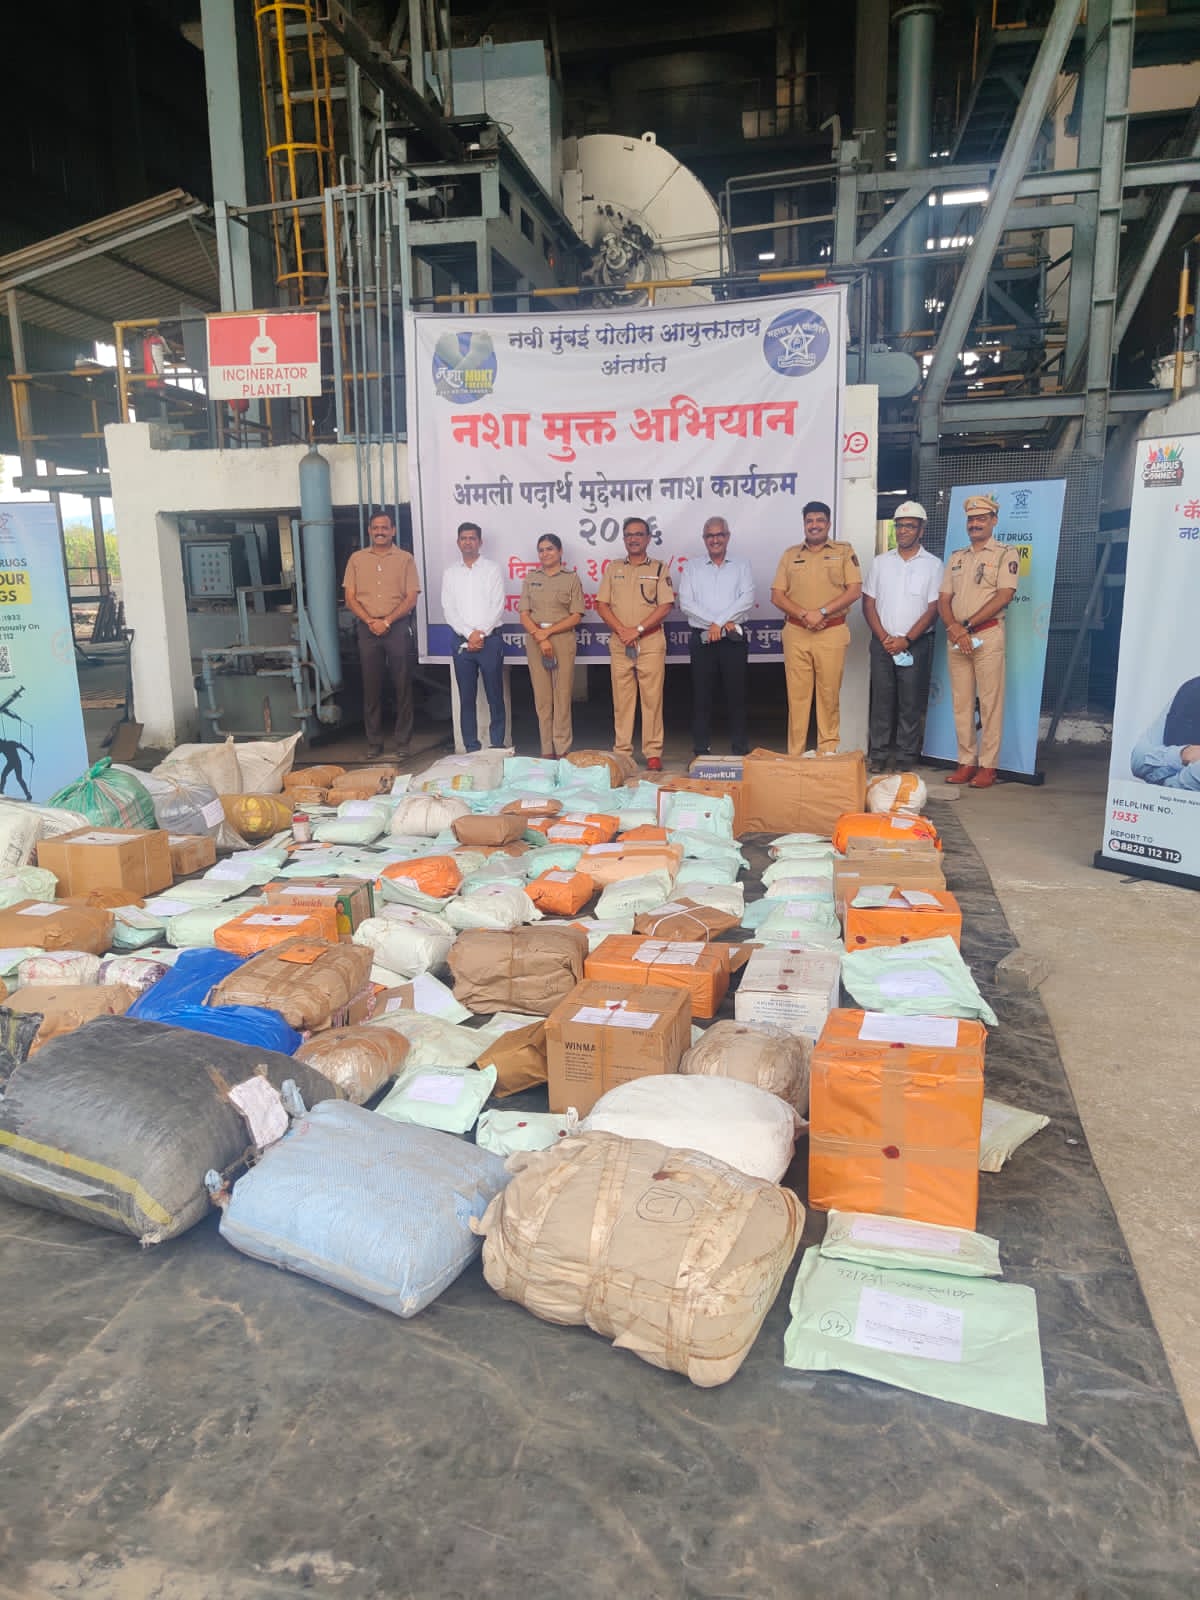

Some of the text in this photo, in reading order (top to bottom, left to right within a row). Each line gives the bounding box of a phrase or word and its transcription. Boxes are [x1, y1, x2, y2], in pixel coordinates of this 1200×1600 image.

[508, 318, 761, 355] नवी मुंबई पोलीस आयुक्तालय
[601, 353, 667, 375] अंतर्गत
[223, 366, 308, 381] INCINERATOR
[450, 394, 799, 463] नशा मुक्त अभियान
[1143, 461, 1180, 471] CAMPUS
[453, 475, 514, 506] अंमली
[519, 472, 573, 509] पदार्थ
[659, 476, 704, 500] नाश
[710, 464, 798, 499] कार्यक्रम
[1007, 533, 1033, 542] DRUGS
[1113, 798, 1174, 815] HELPLINE NO.
[1113, 810, 1138, 823] 1933
[1111, 829, 1153, 843] REPORT TO
[1120, 842, 1180, 862] 8828 112 112
